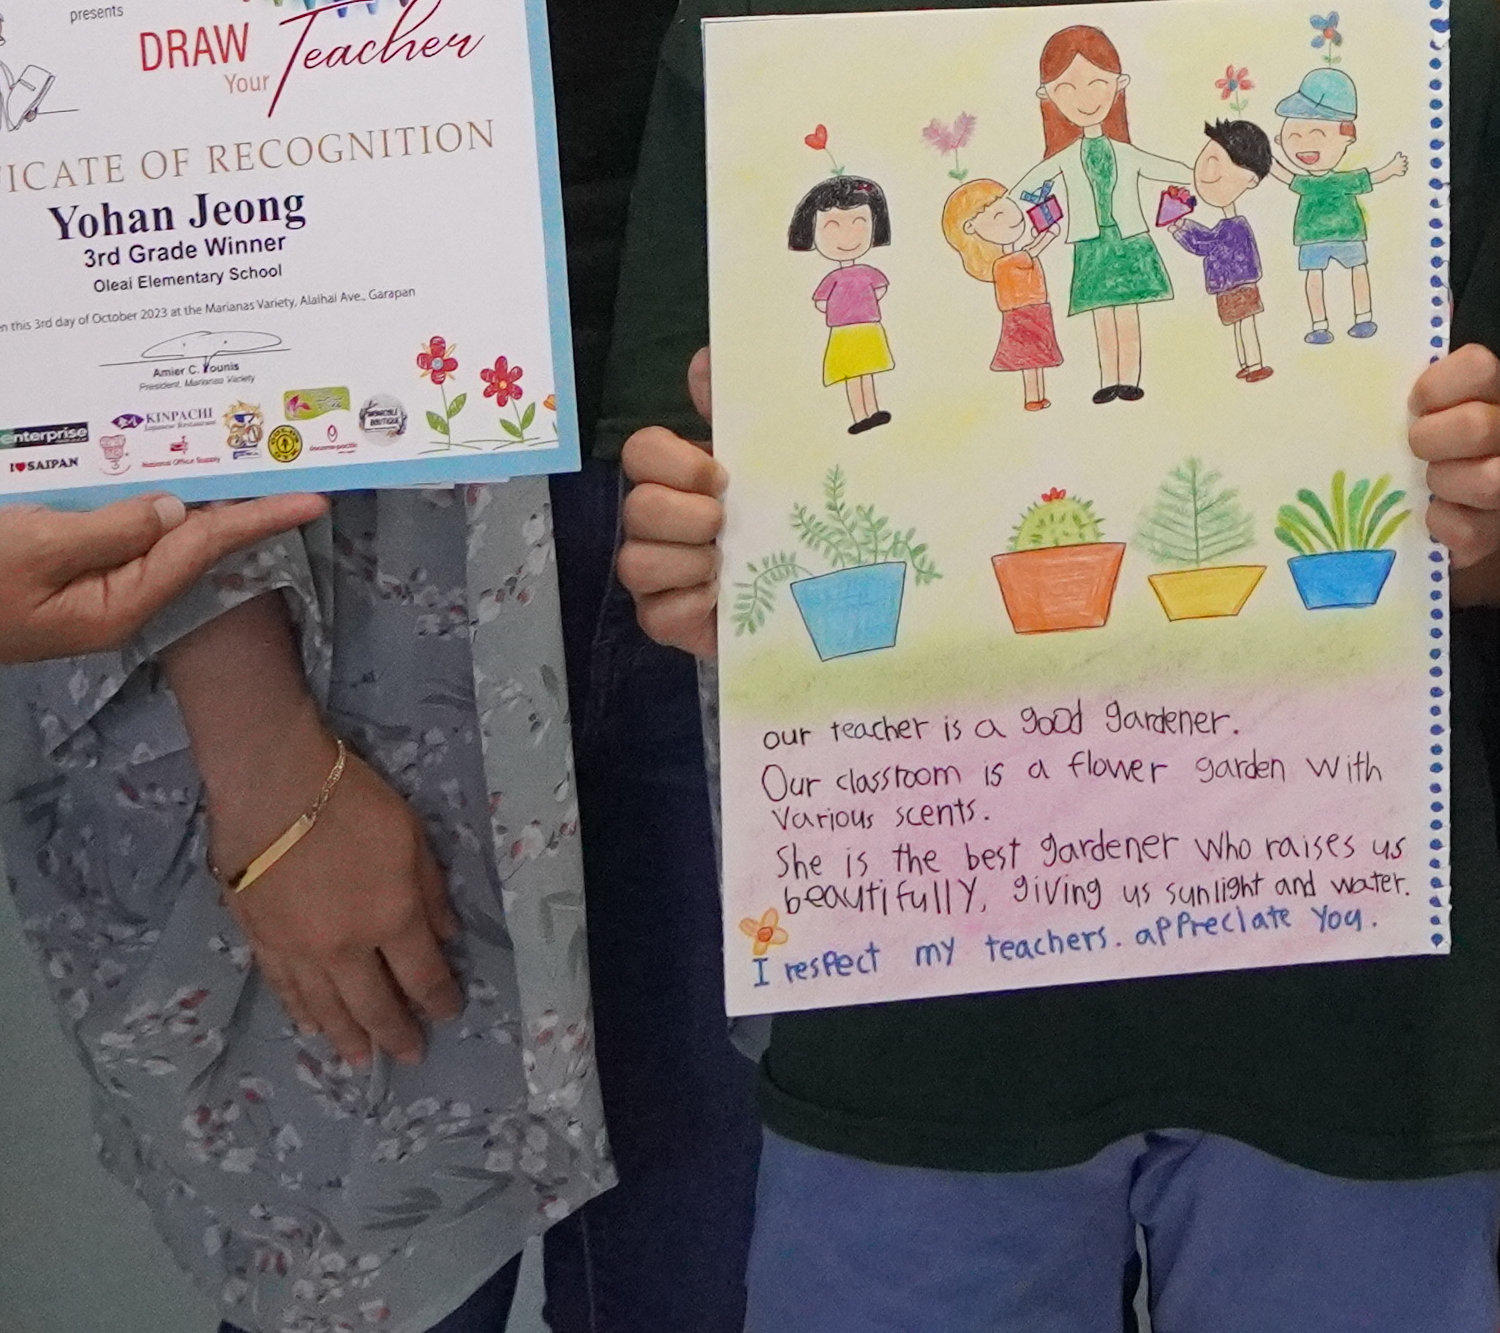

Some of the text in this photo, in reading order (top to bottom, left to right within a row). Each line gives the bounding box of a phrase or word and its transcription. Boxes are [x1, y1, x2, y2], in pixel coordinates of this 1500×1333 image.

[69, 4, 125, 25] presents
[139, 21, 250, 72] DRAW
[223, 73, 271, 95] Your
[140, 147, 190, 183] OF
[207, 118, 497, 176] RECOGNITION
[48, 192, 307, 241] Yohan Jeong
[83, 235, 287, 268] 3rd Grade Winner
[93, 263, 283, 293] Oleai Elementary School
[10, 319, 32, 332] this
[34, 318, 53, 330] 3rd
[55, 315, 76, 329] day
[78, 313, 90, 325] of
[91, 311, 139, 324] October
[140, 307, 168, 320] 2023
[170, 305, 182, 317] at
[184, 304, 203, 316] the
[205, 301, 256, 314] Marianas
[256, 297, 298, 314] Variety,
[368, 287, 416, 300] Garapan
[152, 367, 185, 378] Amier
[188, 364, 200, 375] C.
[184, 376, 225, 387] Marianas
[226, 374, 256, 385] Variety
[145, 407, 214, 424] KINPACHI
[0, 425, 89, 445] enterprise
[27, 457, 79, 472] SAIPAN
[829, 715, 930, 743] teacher
[943, 714, 962, 743] is
[974, 718, 1007, 738] a
[1020, 698, 1084, 736] good
[1105, 699, 1240, 736] gardener.
[761, 763, 821, 802] Our
[835, 764, 962, 795] classroom
[984, 761, 1005, 788] is
[1028, 758, 1051, 780] a
[1067, 749, 1169, 784] flower
[1195, 748, 1286, 784] garden
[895, 797, 991, 828] scents.
[776, 842, 823, 881] She
[846, 847, 869, 878] is
[891, 842, 941, 875] the
[964, 836, 1021, 872] best
[1040, 828, 1179, 867] gardener
[1265, 833, 1356, 862] raises
[1372, 835, 1408, 861] us
[1012, 873, 1102, 911] giving
[1122, 881, 1151, 909] us
[1165, 871, 1266, 908] sunlight
[1274, 869, 1316, 898] and
[1330, 871, 1412, 898] water.
[752, 956, 771, 988] I
[914, 936, 956, 968] my
